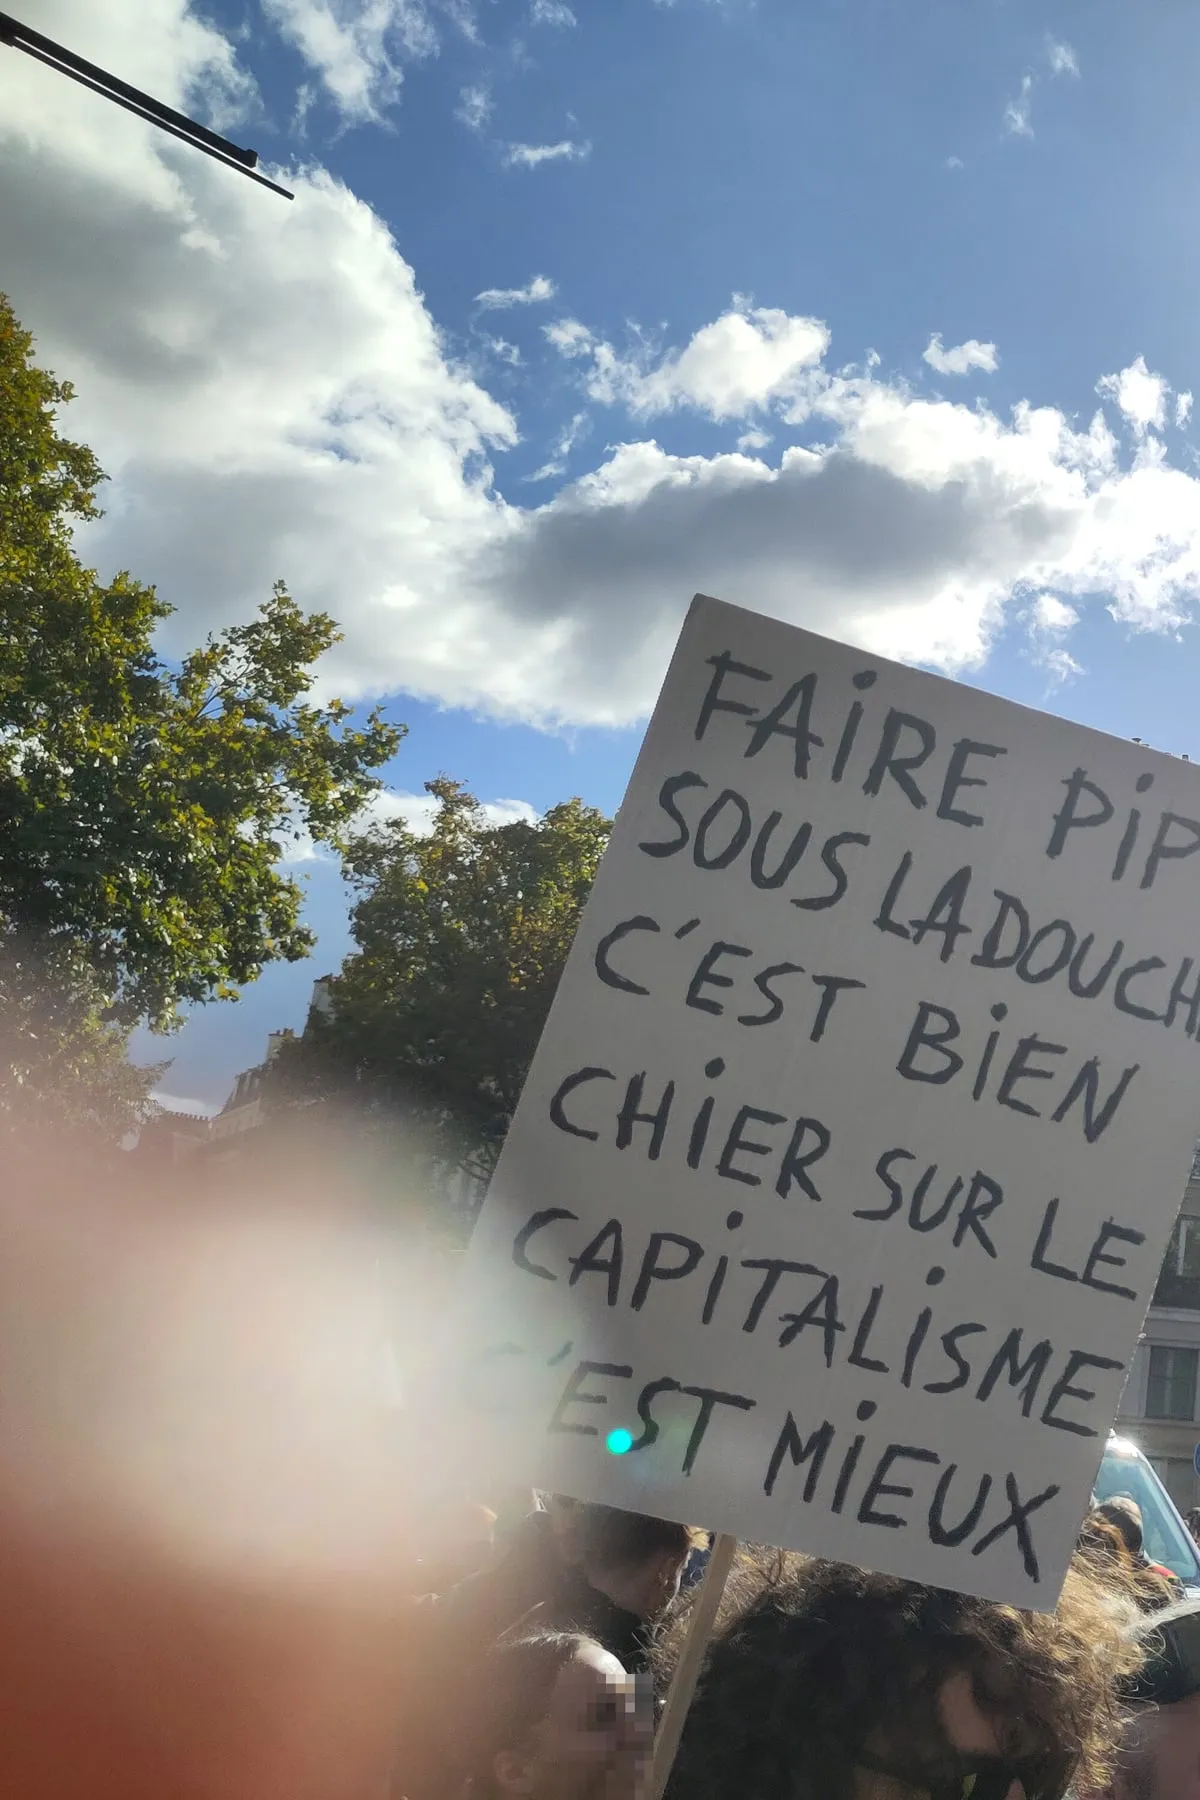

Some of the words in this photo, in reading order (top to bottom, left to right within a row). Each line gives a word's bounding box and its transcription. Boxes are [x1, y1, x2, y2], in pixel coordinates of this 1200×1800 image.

[638, 770, 871, 911] SOUS
[594, 914, 866, 1042] C'EST
[852, 1148, 1004, 1260] SUR
[1031, 1198, 1147, 1301] LE
[488, 1338, 757, 1477] 'EST
